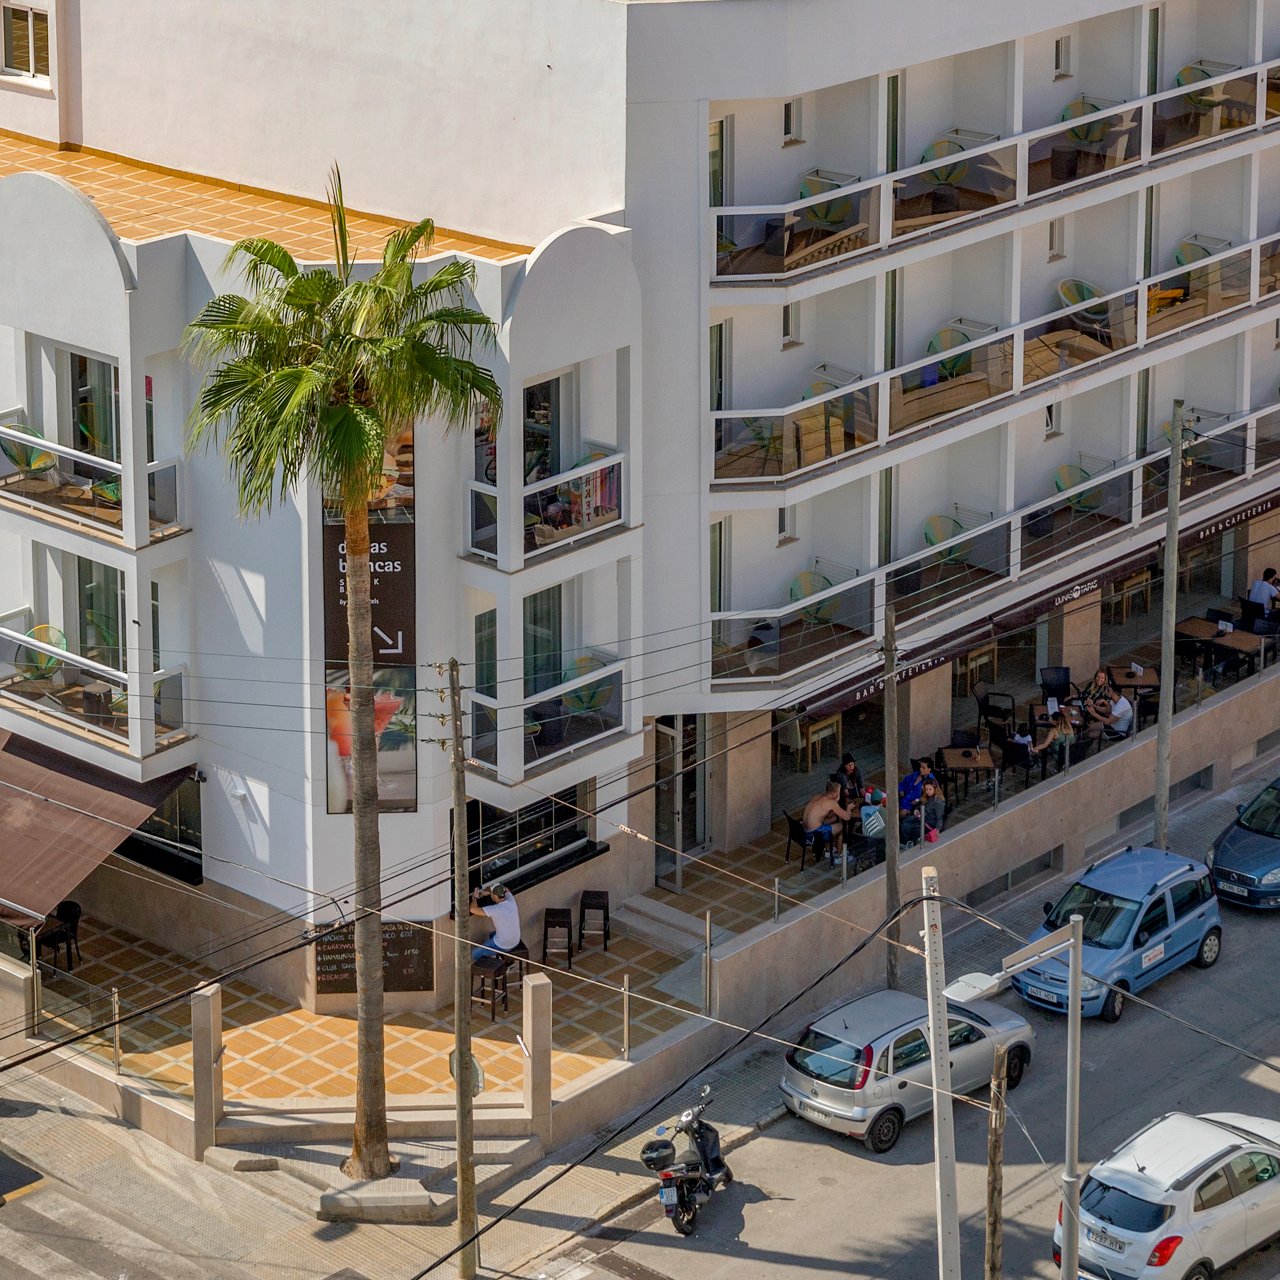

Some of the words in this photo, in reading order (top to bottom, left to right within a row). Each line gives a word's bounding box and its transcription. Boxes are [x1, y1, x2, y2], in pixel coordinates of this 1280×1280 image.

[1199, 526, 1216, 539] BAR
[1225, 501, 1272, 526] CAFETERIA
[338, 540, 388, 554] das
[338, 558, 402, 573] bncas
[856, 686, 875, 700] BAR
